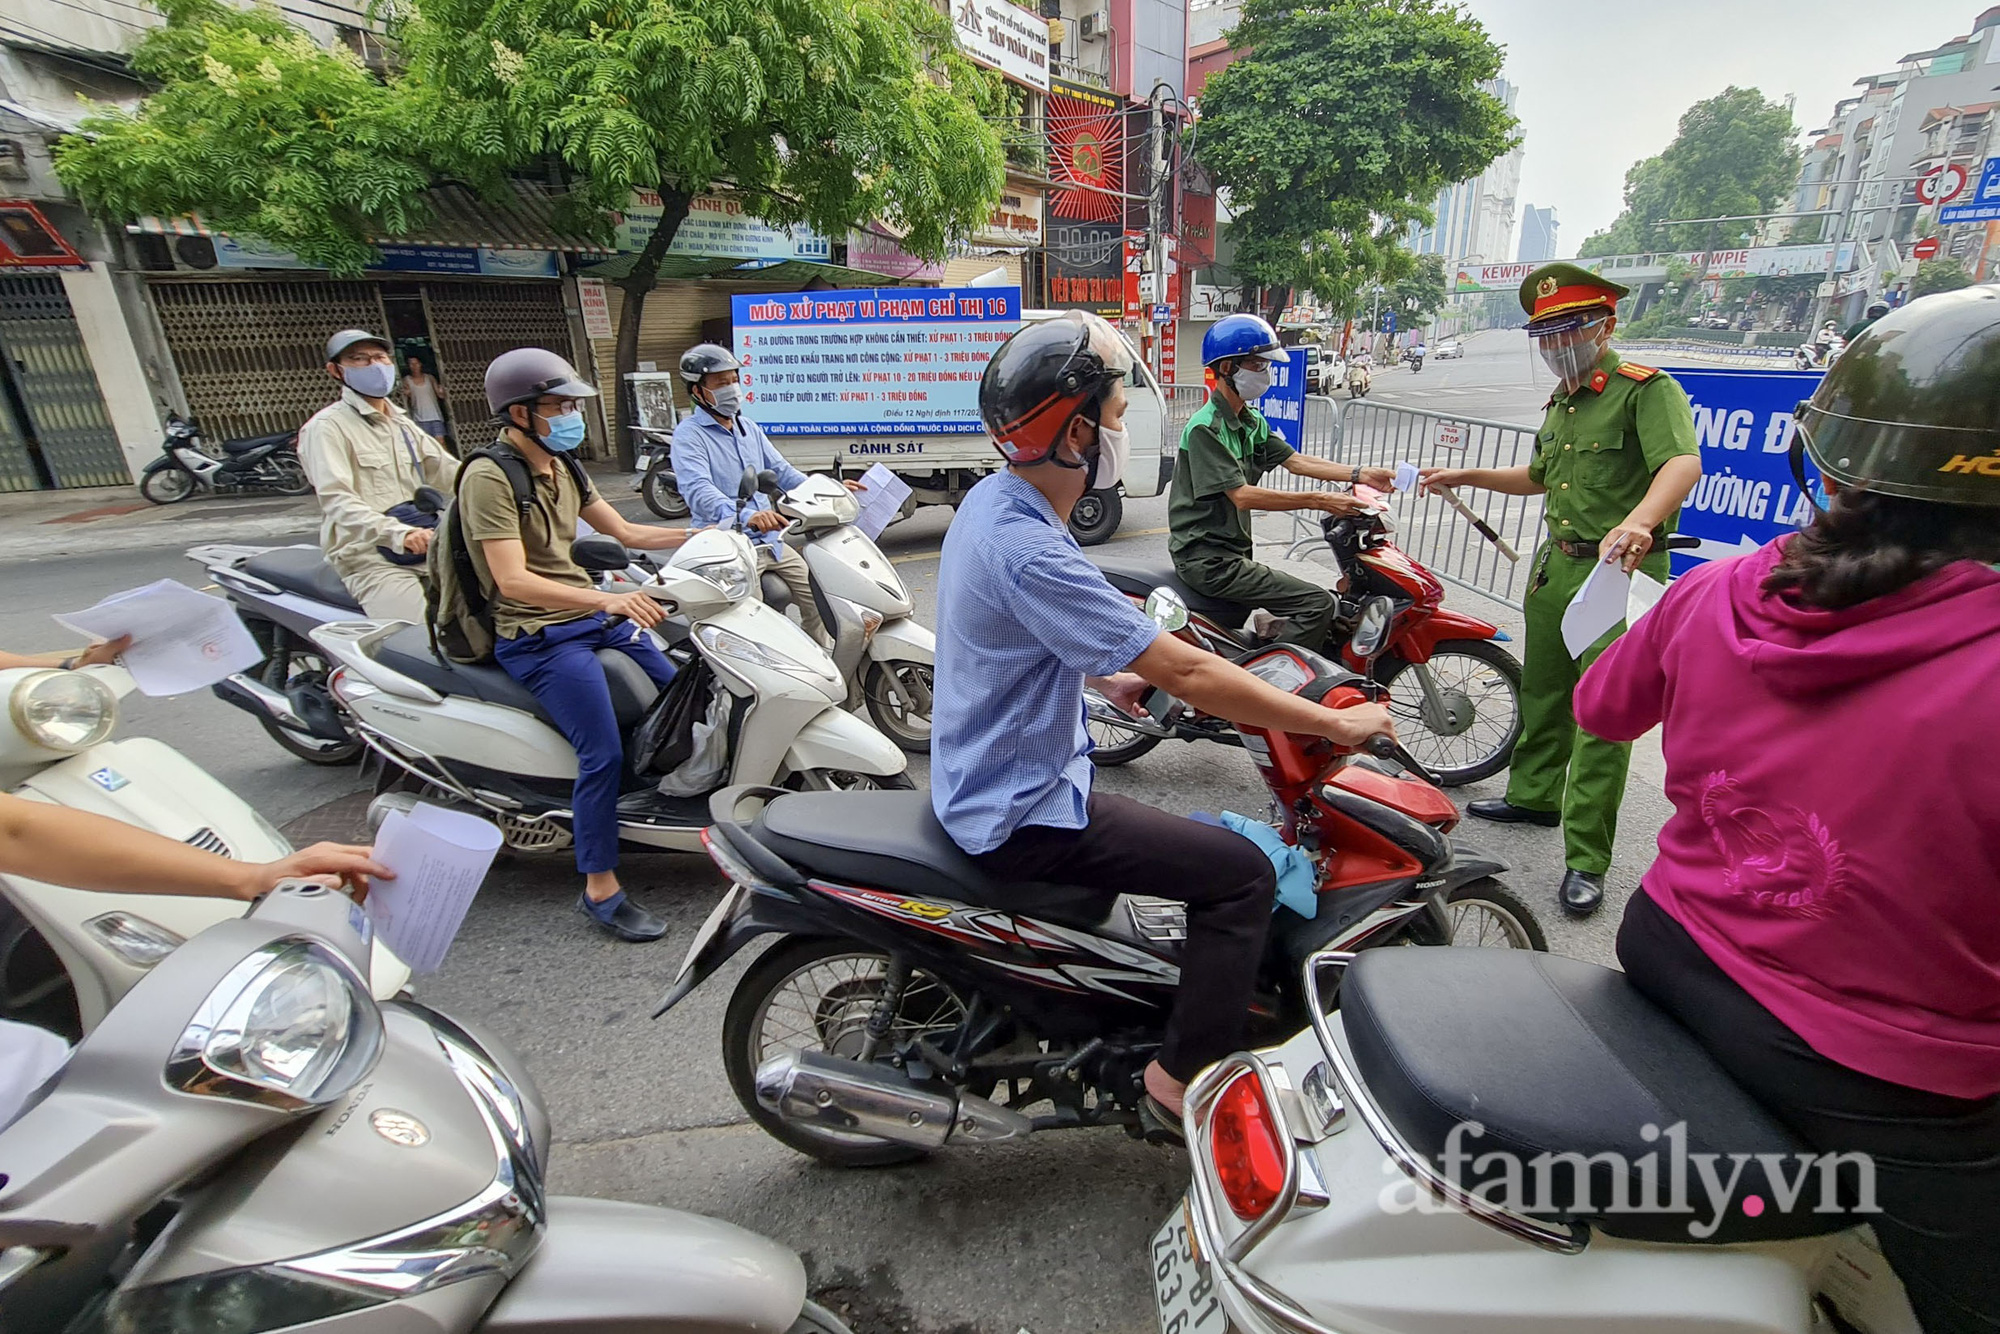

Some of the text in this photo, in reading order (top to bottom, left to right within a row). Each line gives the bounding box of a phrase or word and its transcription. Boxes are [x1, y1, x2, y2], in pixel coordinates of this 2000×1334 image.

[988, 24, 1006, 49] TÂN
[1006, 37, 1028, 60] TOÀN
[1028, 48, 1045, 69] ANH
[750, 292, 1007, 322] MỨC XỬ PHẠT VI PHẠM CHỈ THỊ 16
[759, 337, 768, 346] RA
[770, 333, 794, 346] ĐƯỜNG
[796, 335, 819, 345] TRONG
[820, 332, 848, 345] TRƯỜNG
[849, 333, 863, 346] HỢP
[865, 332, 889, 343] KHÔNG
[928, 329, 939, 342] XỬ
[940, 333, 957, 345] PHẠT
[974, 331, 993, 345] TRIỆU
[759, 353, 783, 365] KHÔNG
[785, 355, 799, 364] ĐEO
[801, 351, 820, 364] KHẨU
[821, 354, 844, 365] TRANG
[846, 353, 858, 364] NƠI
[860, 352, 879, 363] CÔNG
[903, 349, 913, 362] XỬ
[914, 353, 932, 365] PHẠT
[951, 350, 970, 364] TRIỆU
[971, 349, 990, 362] ĐỒNG
[760, 373, 768, 385] TỤ
[770, 372, 784, 386] TẬP
[785, 371, 795, 383] TỪ
[796, 374, 805, 383] 03
[806, 372, 829, 383] NGƯỜI
[830, 369, 844, 382] TRỞ
[862, 368, 872, 381] XỬ
[873, 372, 891, 384] PHẠT
[907, 372, 916, 381] 20
[918, 371, 937, 384] TRIỆU
[938, 368, 957, 381] ĐỒNG
[959, 369, 973, 382] NẾU
[760, 393, 777, 403] GIAO
[780, 389, 794, 402] TIẾP
[796, 390, 813, 402] DƯỚI
[840, 388, 850, 401] XỬ
[851, 392, 869, 404] PHẠT
[887, 390, 906, 404] TRIỆU
[908, 388, 928, 401] ĐỒNG
[771, 424, 784, 433] GIỮ
[800, 424, 821, 433] TOÀN
[841, 425, 856, 434] BẠN
[858, 424, 869, 433] VÀ
[871, 424, 892, 434] CỘNG
[894, 422, 915, 432] ĐỒNG
[917, 423, 942, 432] TRƯỚC
[943, 424, 956, 433] ĐẠI
[958, 424, 975, 433] DỊCH
[850, 438, 924, 454] CẢNH SÁT
[1440, 434, 1460, 444] STOP
[1415, 879, 1447, 889] HONDA
[326, 1083, 374, 1136] HONDA
